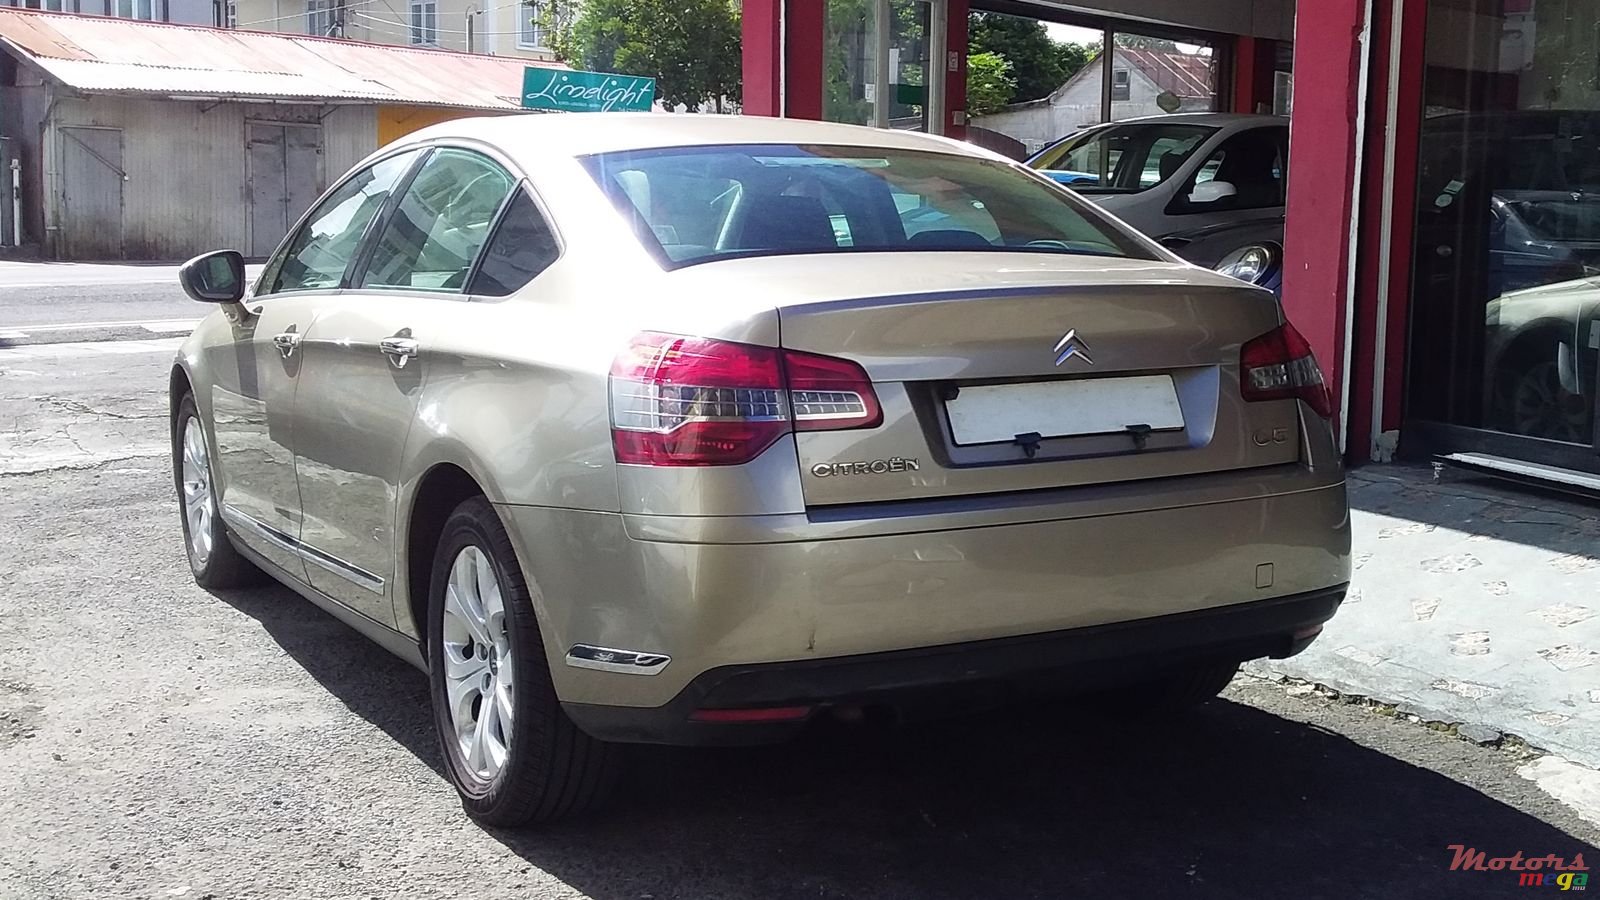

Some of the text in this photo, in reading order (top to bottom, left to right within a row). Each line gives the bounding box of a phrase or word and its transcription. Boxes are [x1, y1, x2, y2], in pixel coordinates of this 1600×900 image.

[526, 72, 652, 112] Limelight
[1252, 426, 1288, 447] C5
[812, 457, 920, 477] CITROËN
